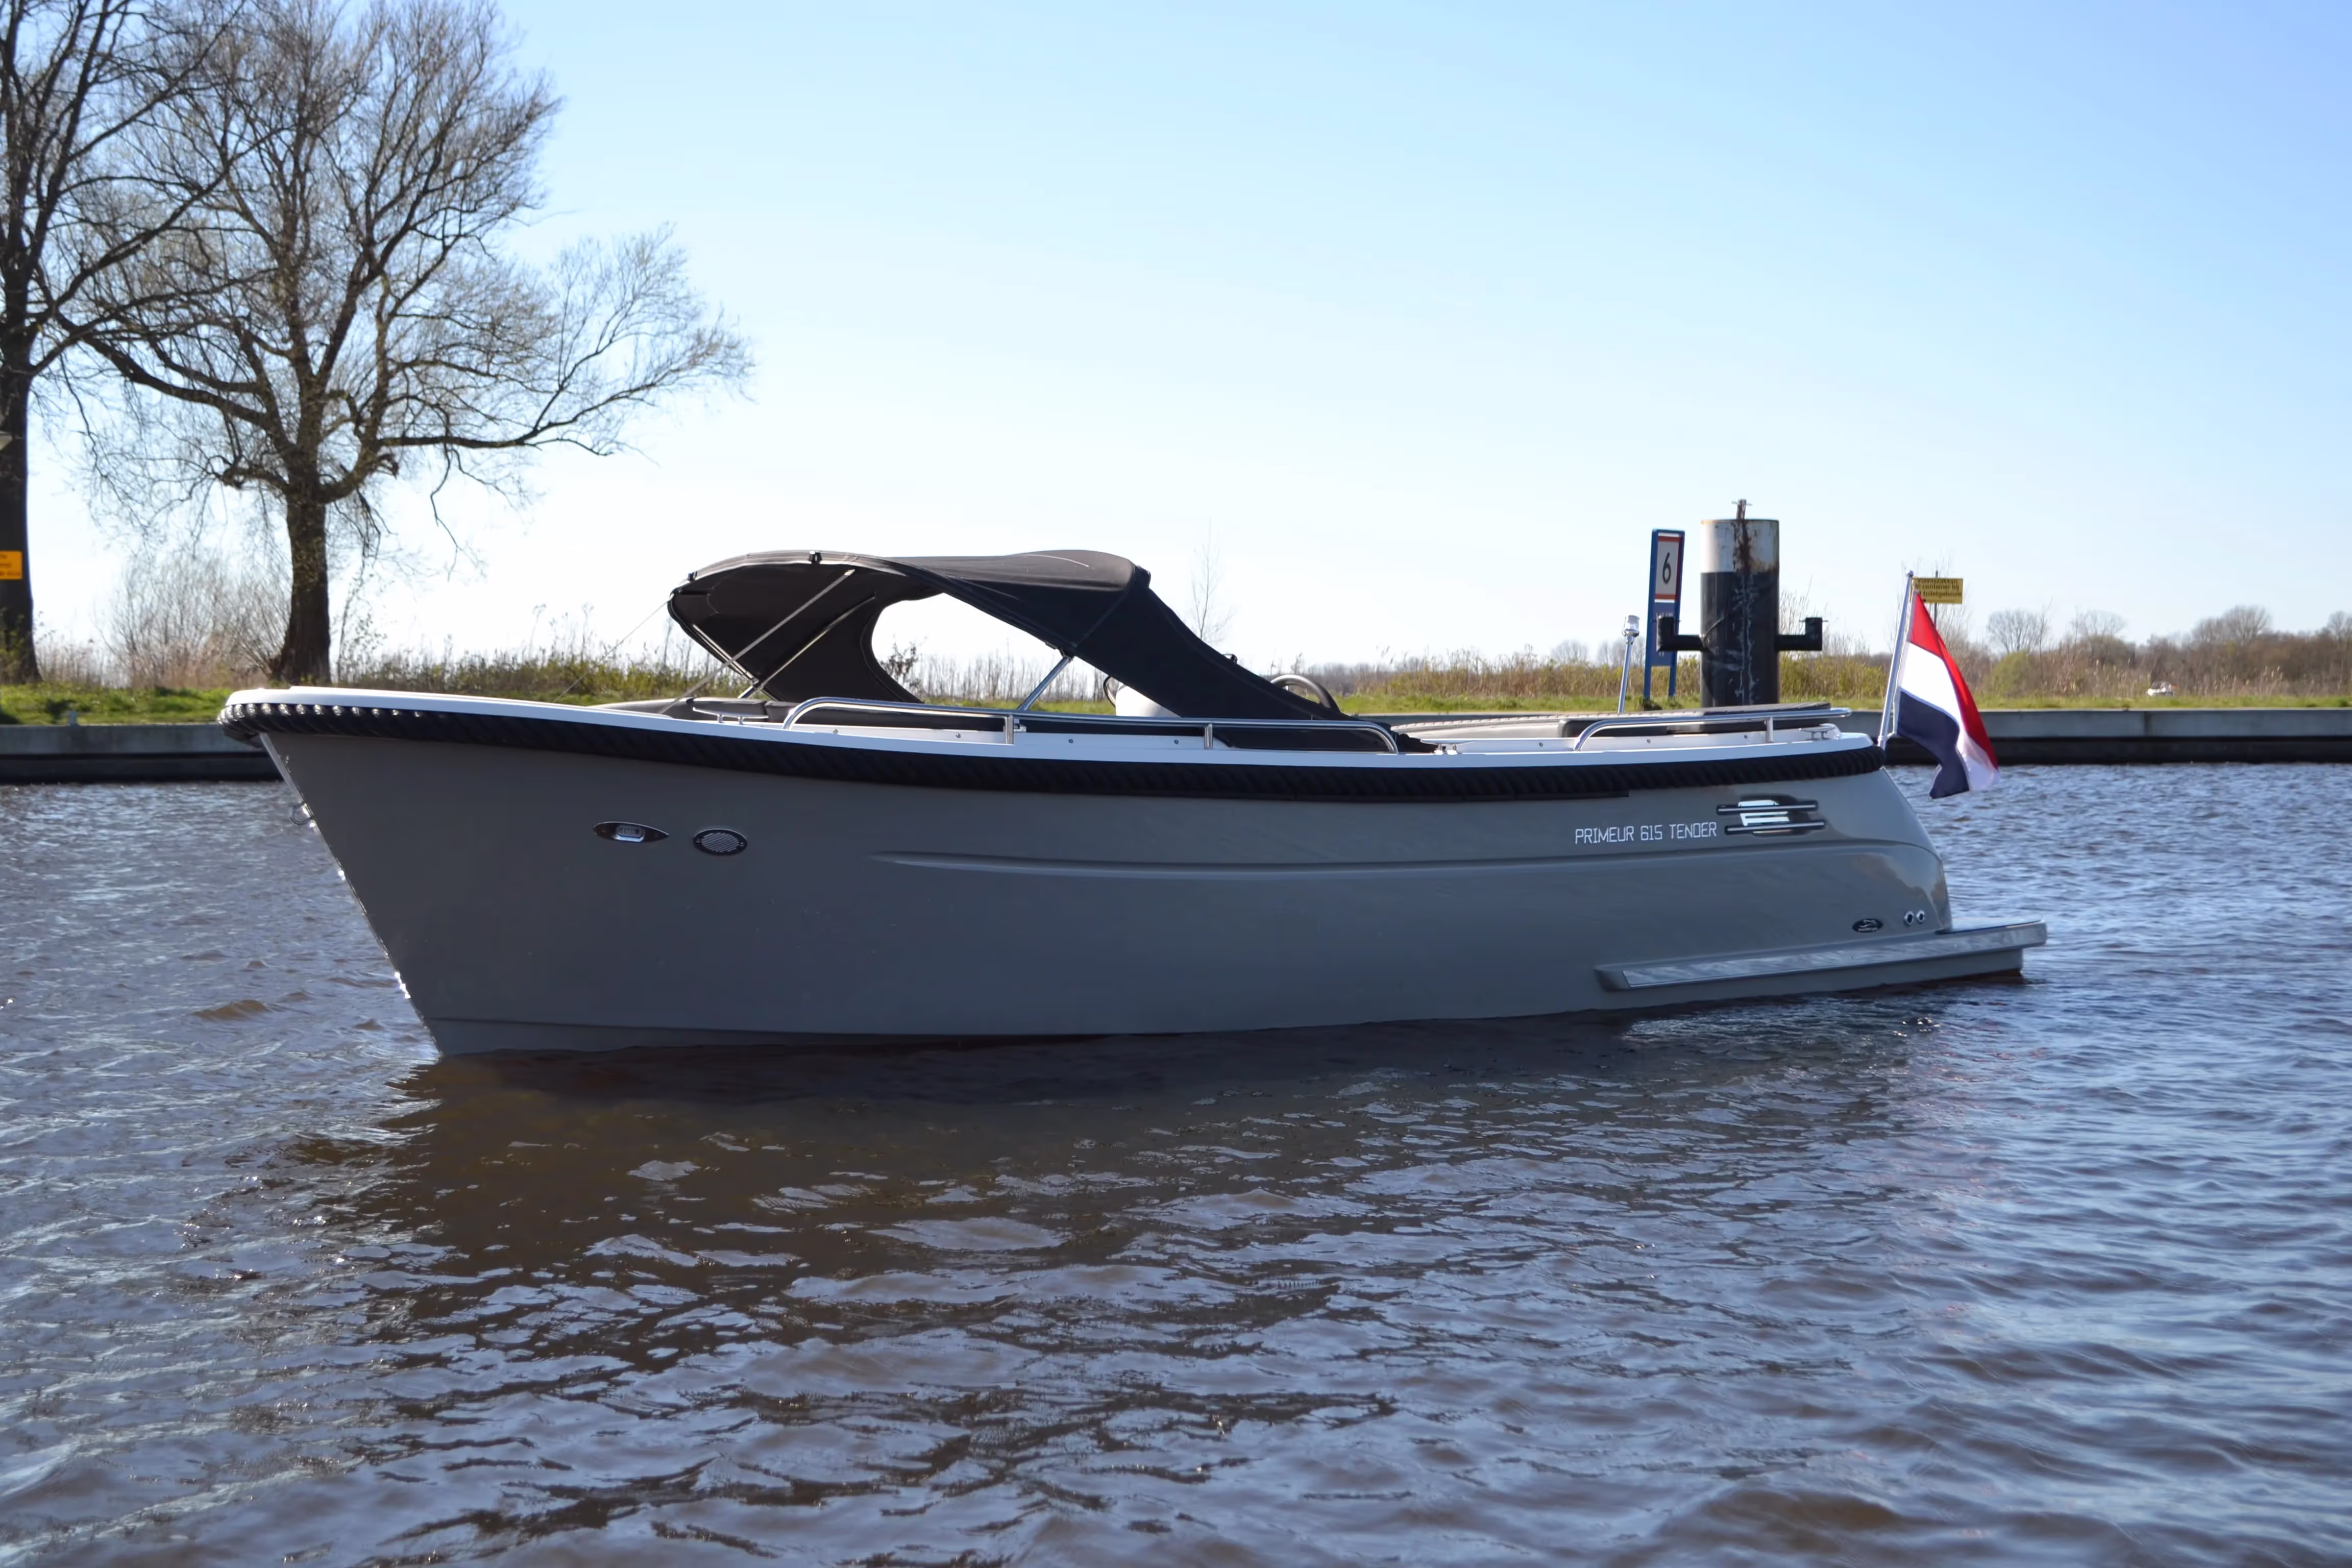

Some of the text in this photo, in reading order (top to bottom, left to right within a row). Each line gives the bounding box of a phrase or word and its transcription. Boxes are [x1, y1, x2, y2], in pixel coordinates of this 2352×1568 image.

[1662, 552, 1672, 584] 6
[1575, 822, 1717, 844] PRIMEUR 615 TENDER
